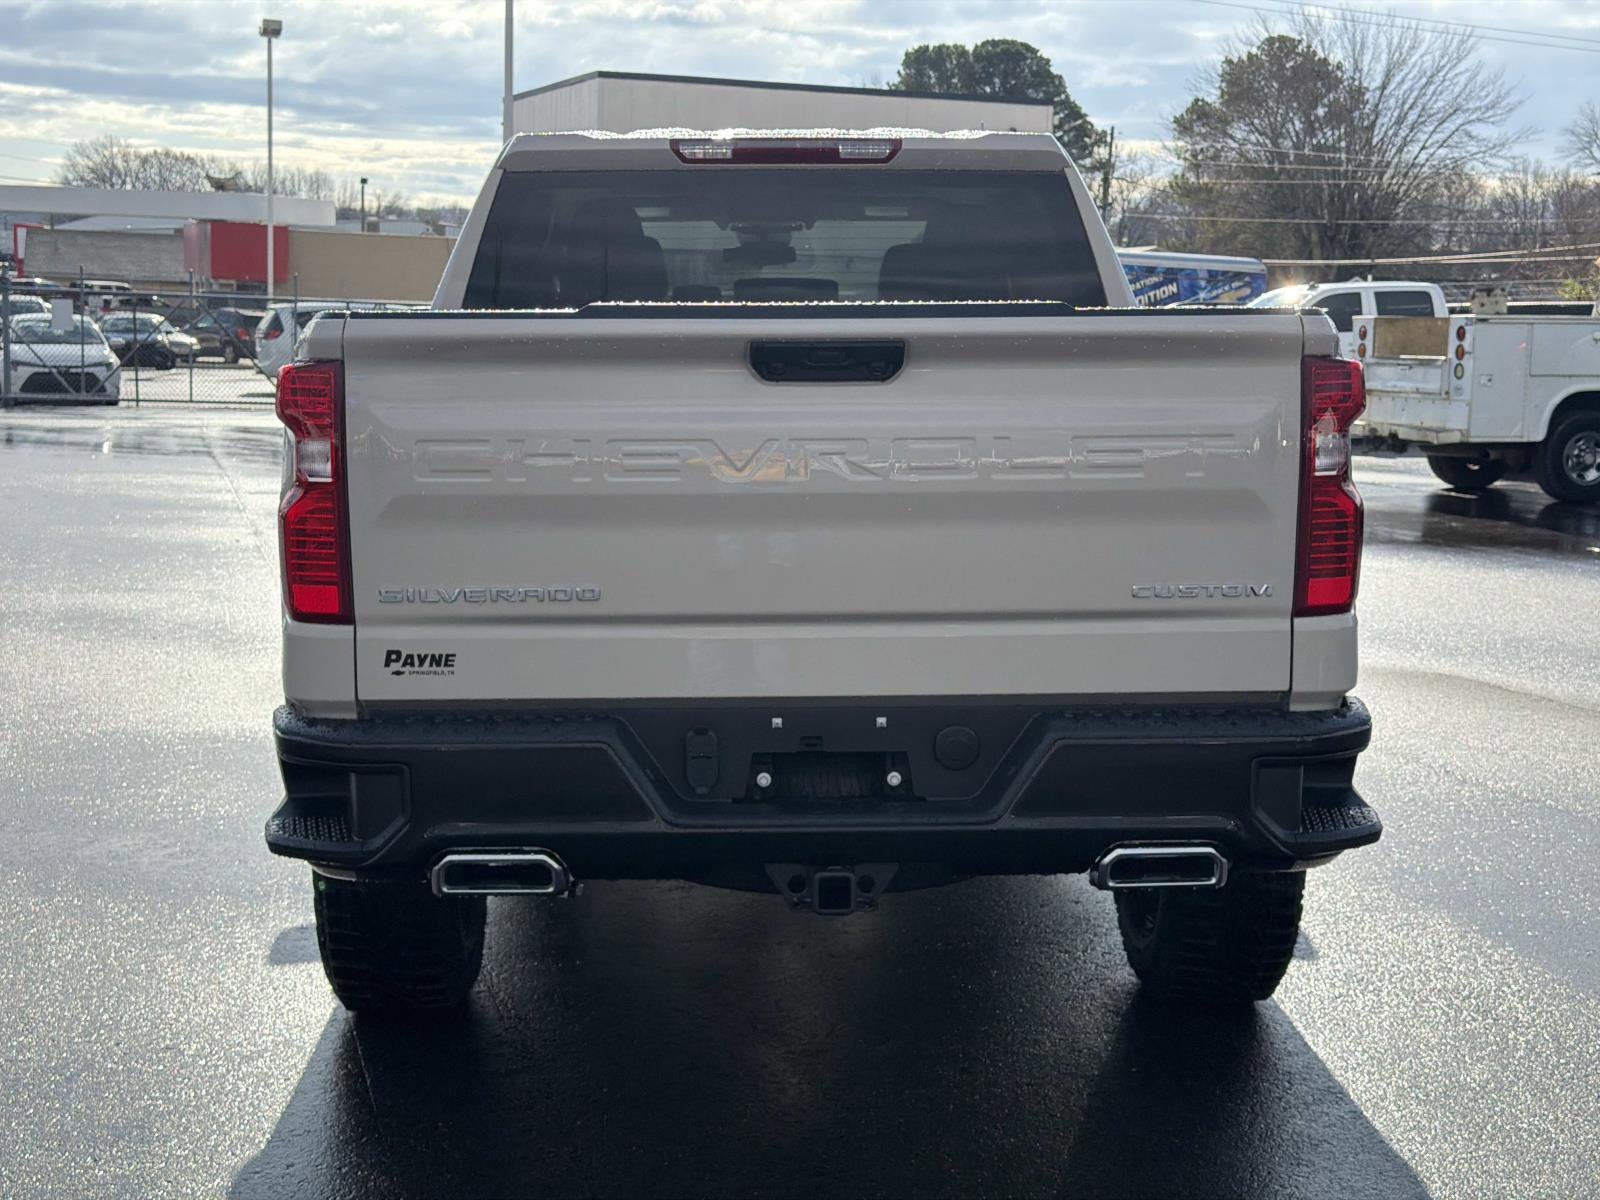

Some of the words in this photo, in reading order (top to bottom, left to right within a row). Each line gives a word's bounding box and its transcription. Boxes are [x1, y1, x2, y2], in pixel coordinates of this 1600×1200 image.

[413, 434, 1236, 483] CHEVROLET
[378, 586, 602, 604] SILVERADO
[1131, 583, 1273, 599] CUSTOM
[384, 649, 457, 668] PAYNE
